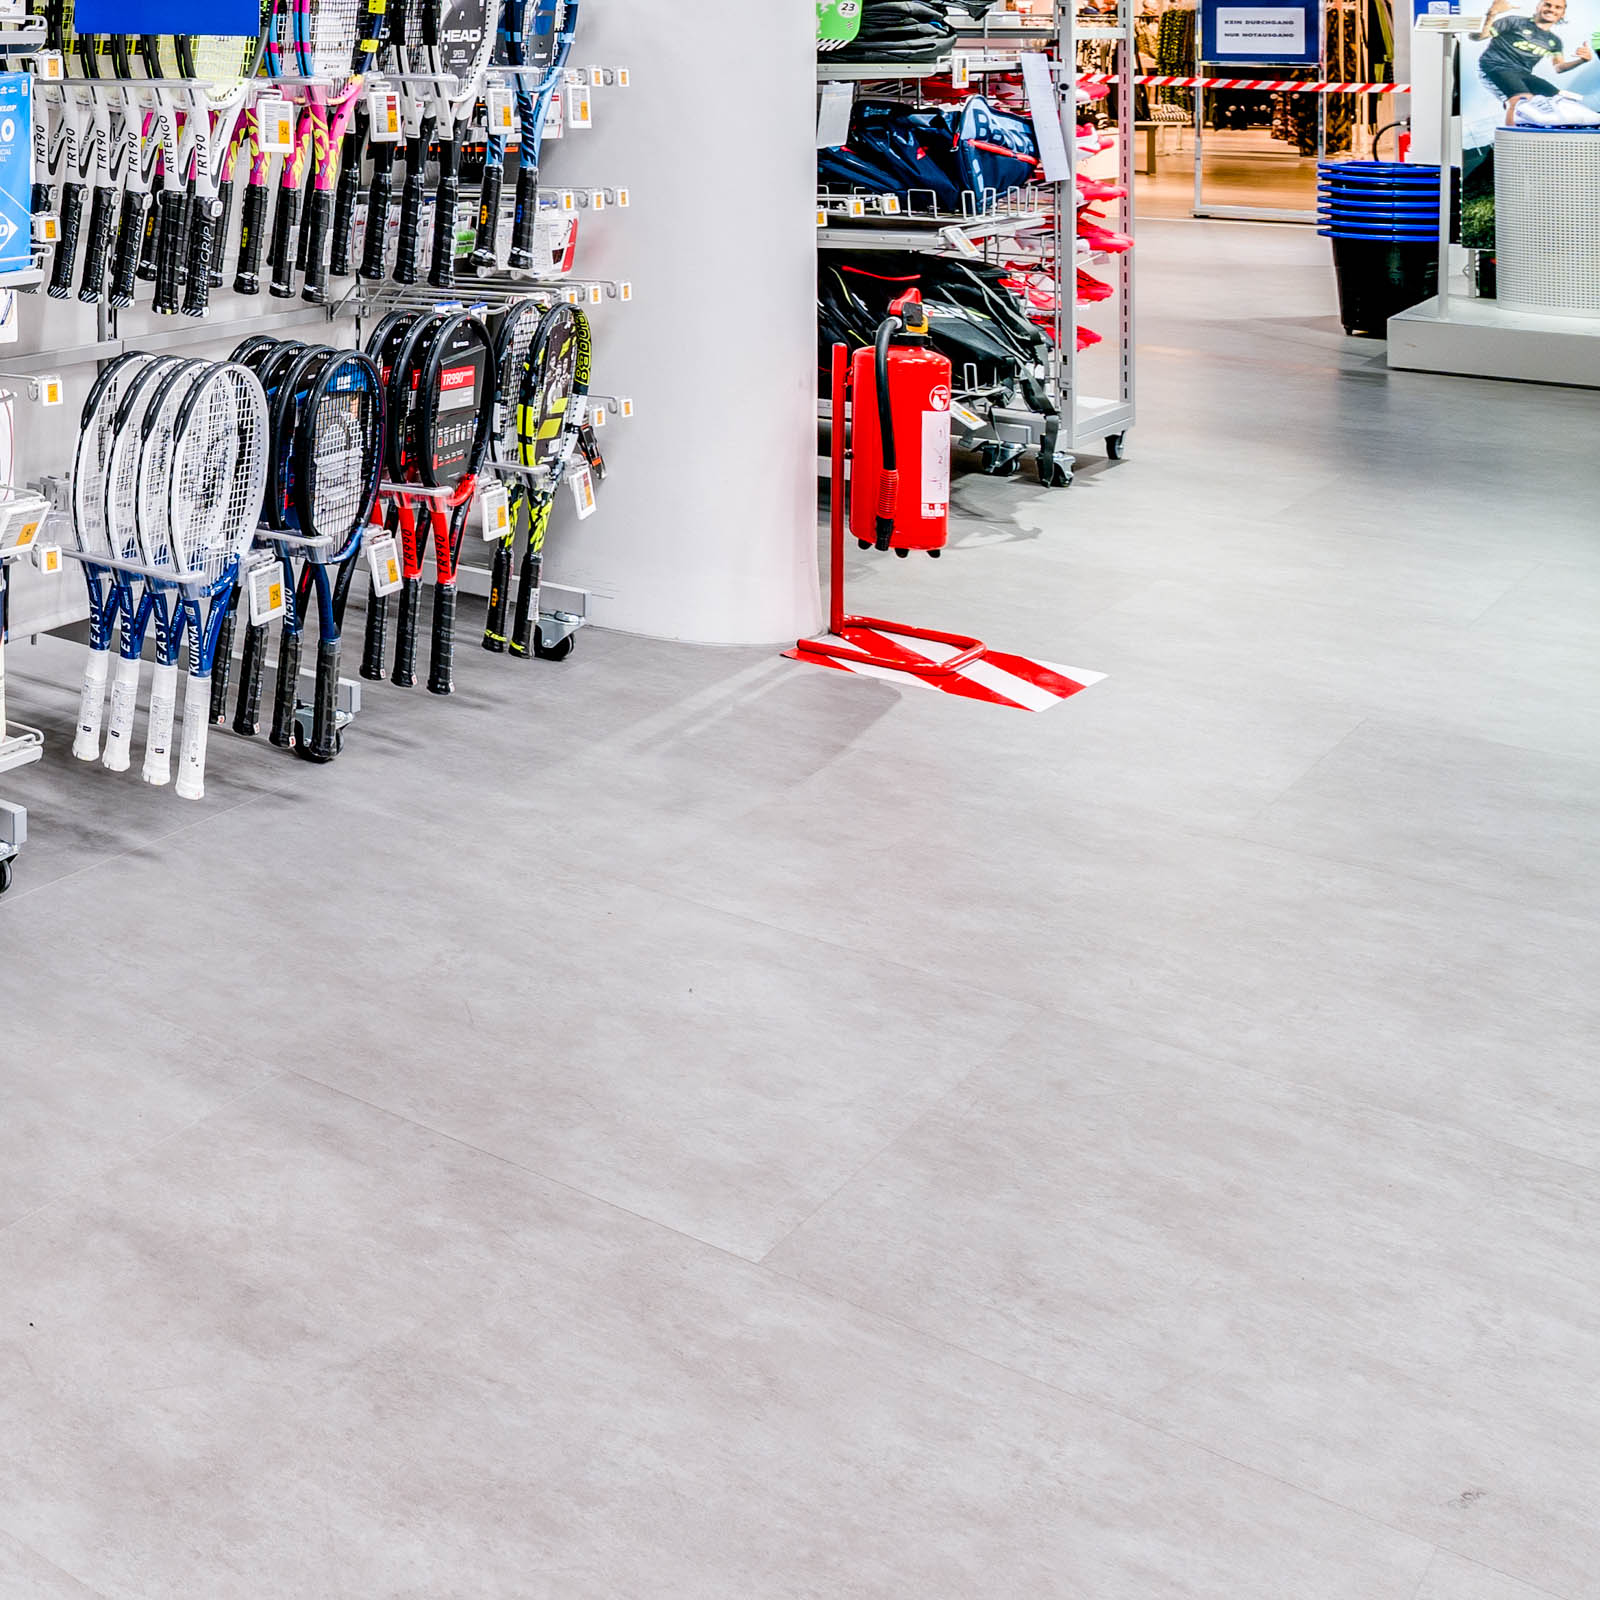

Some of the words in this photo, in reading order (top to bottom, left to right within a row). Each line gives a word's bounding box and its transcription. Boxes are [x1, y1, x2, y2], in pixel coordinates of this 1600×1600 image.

[841, 3, 855, 12] 23
[441, 29, 481, 43] HEAD
[164, 115, 175, 173] ARTENGO
[197, 134, 207, 177] TR190
[90, 601, 100, 645] EASY
[189, 625, 200, 674] KUIKMA
